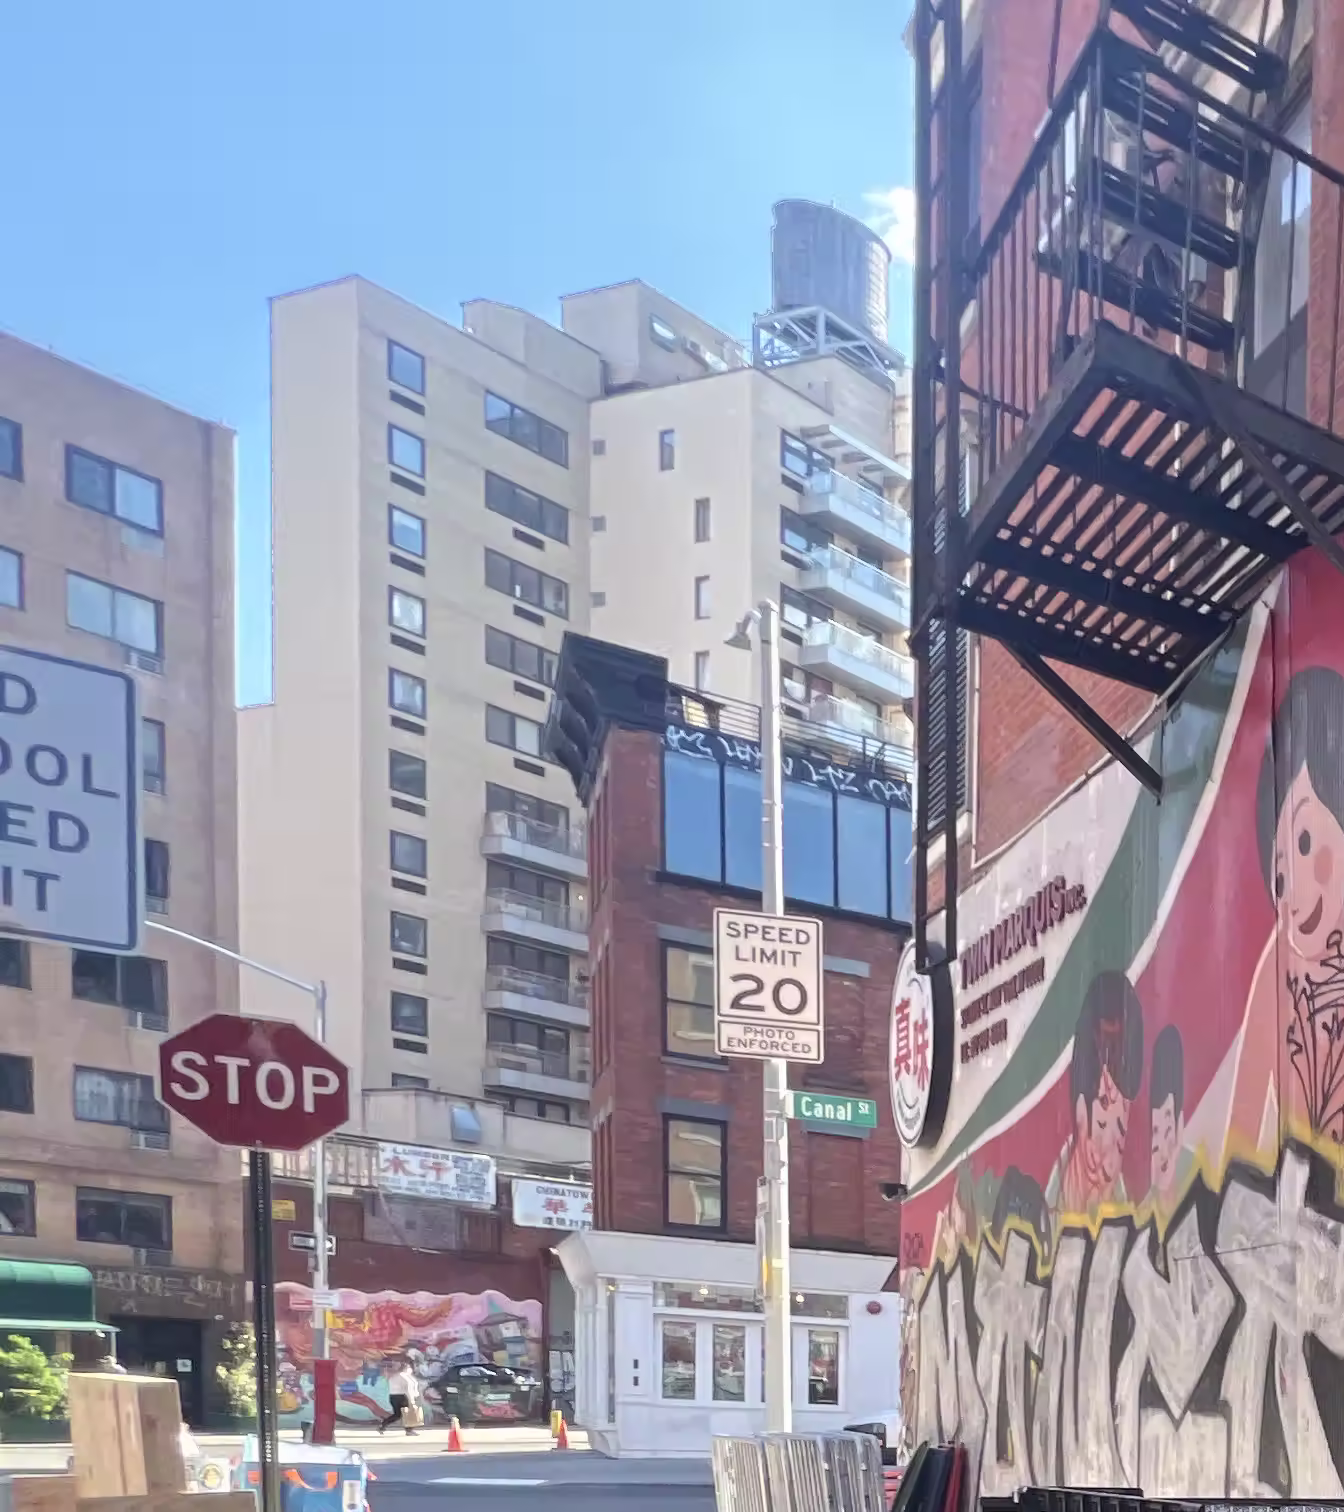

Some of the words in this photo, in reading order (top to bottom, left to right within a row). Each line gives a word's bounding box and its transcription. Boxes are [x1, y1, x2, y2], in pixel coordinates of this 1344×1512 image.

[726, 921, 811, 945] SPEED
[735, 945, 802, 967] LIMIT
[729, 973, 808, 1015] 20
[727, 1037, 812, 1054] ENFORCED
[743, 1026, 796, 1041] PHOTO
[169, 1050, 340, 1114] STOP
[801, 1096, 852, 1121] Canal
